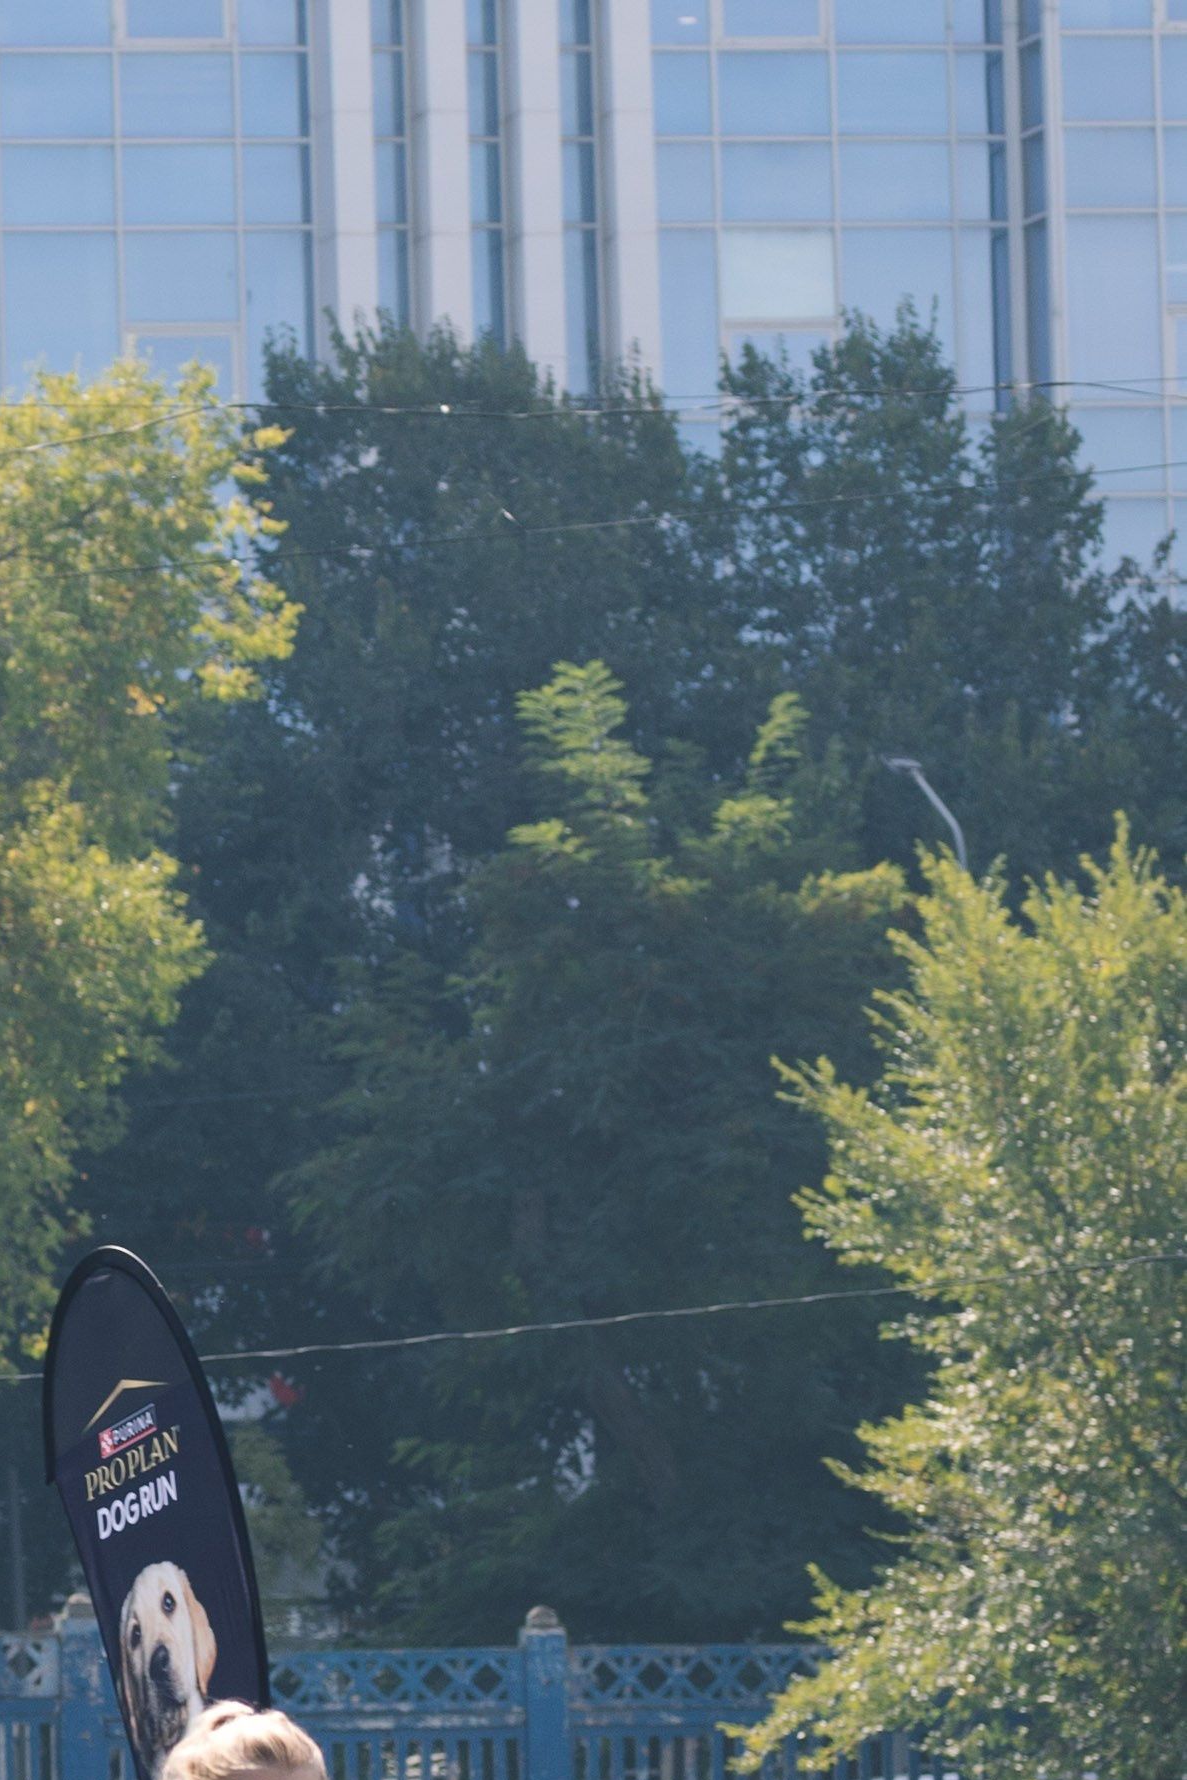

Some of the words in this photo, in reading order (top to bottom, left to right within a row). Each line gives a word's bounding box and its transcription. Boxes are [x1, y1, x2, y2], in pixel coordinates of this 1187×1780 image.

[112, 1411, 154, 1445] PURINA
[84, 1457, 127, 1502] PRO
[126, 1425, 180, 1480] PLAN
[96, 1492, 140, 1540] DOG
[139, 1470, 178, 1518] RUN
